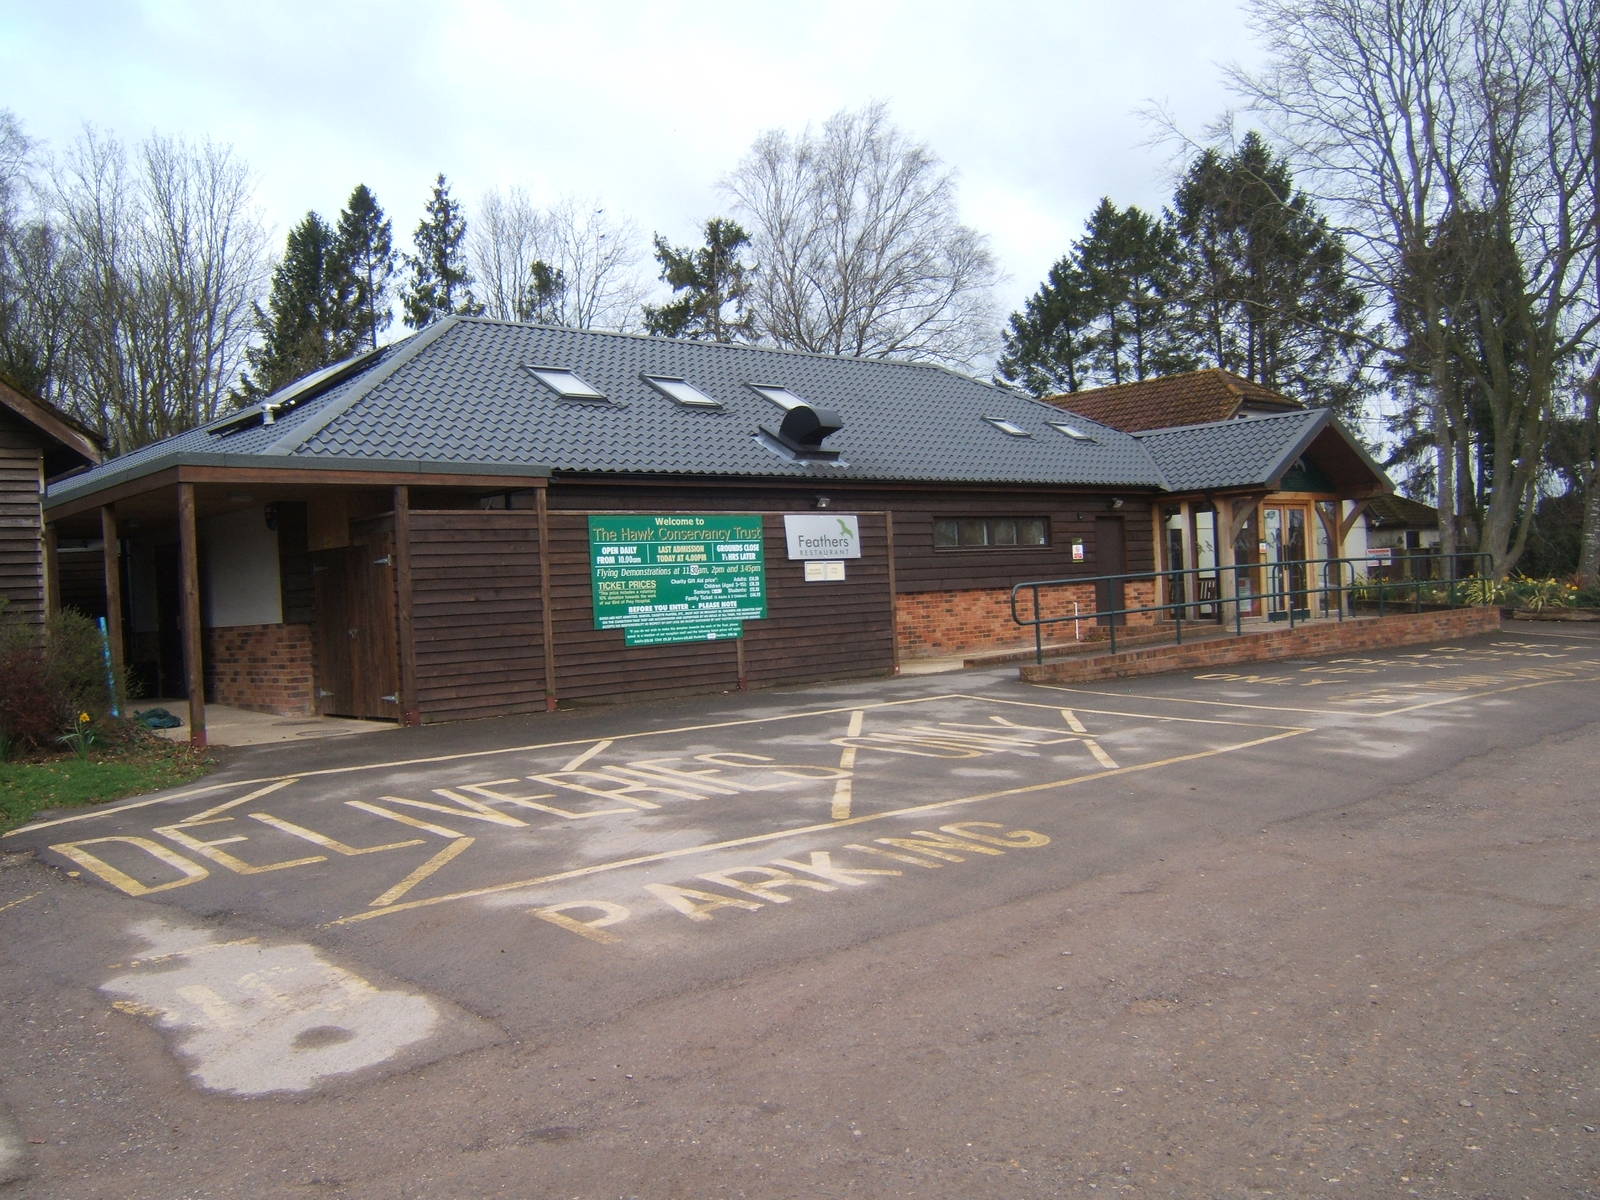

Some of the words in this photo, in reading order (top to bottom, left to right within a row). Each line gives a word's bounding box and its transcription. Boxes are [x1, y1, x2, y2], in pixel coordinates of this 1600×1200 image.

[655, 518, 693, 526] Welcome
[592, 528, 617, 542] The
[622, 528, 654, 541] Hawk
[658, 528, 730, 542] Conservancy
[733, 528, 762, 540] Trust
[798, 534, 849, 548] Feathers
[602, 546, 618, 554] OPEN
[620, 546, 637, 554] DAILY
[672, 545, 704, 553] ADMISSION
[596, 568, 618, 579] Flying
[621, 567, 671, 576] Demonstrations
[711, 566, 724, 575] 2pm
[598, 581, 626, 590] TICKET
[628, 580, 656, 589] PRICES
[1329, 658, 1463, 669] PICK
[1193, 673, 1349, 686] ONLY
[48, 752, 853, 897] DELIVERIES
[830, 716, 1097, 759] ONLY
[528, 822, 1051, 945] PARKING
